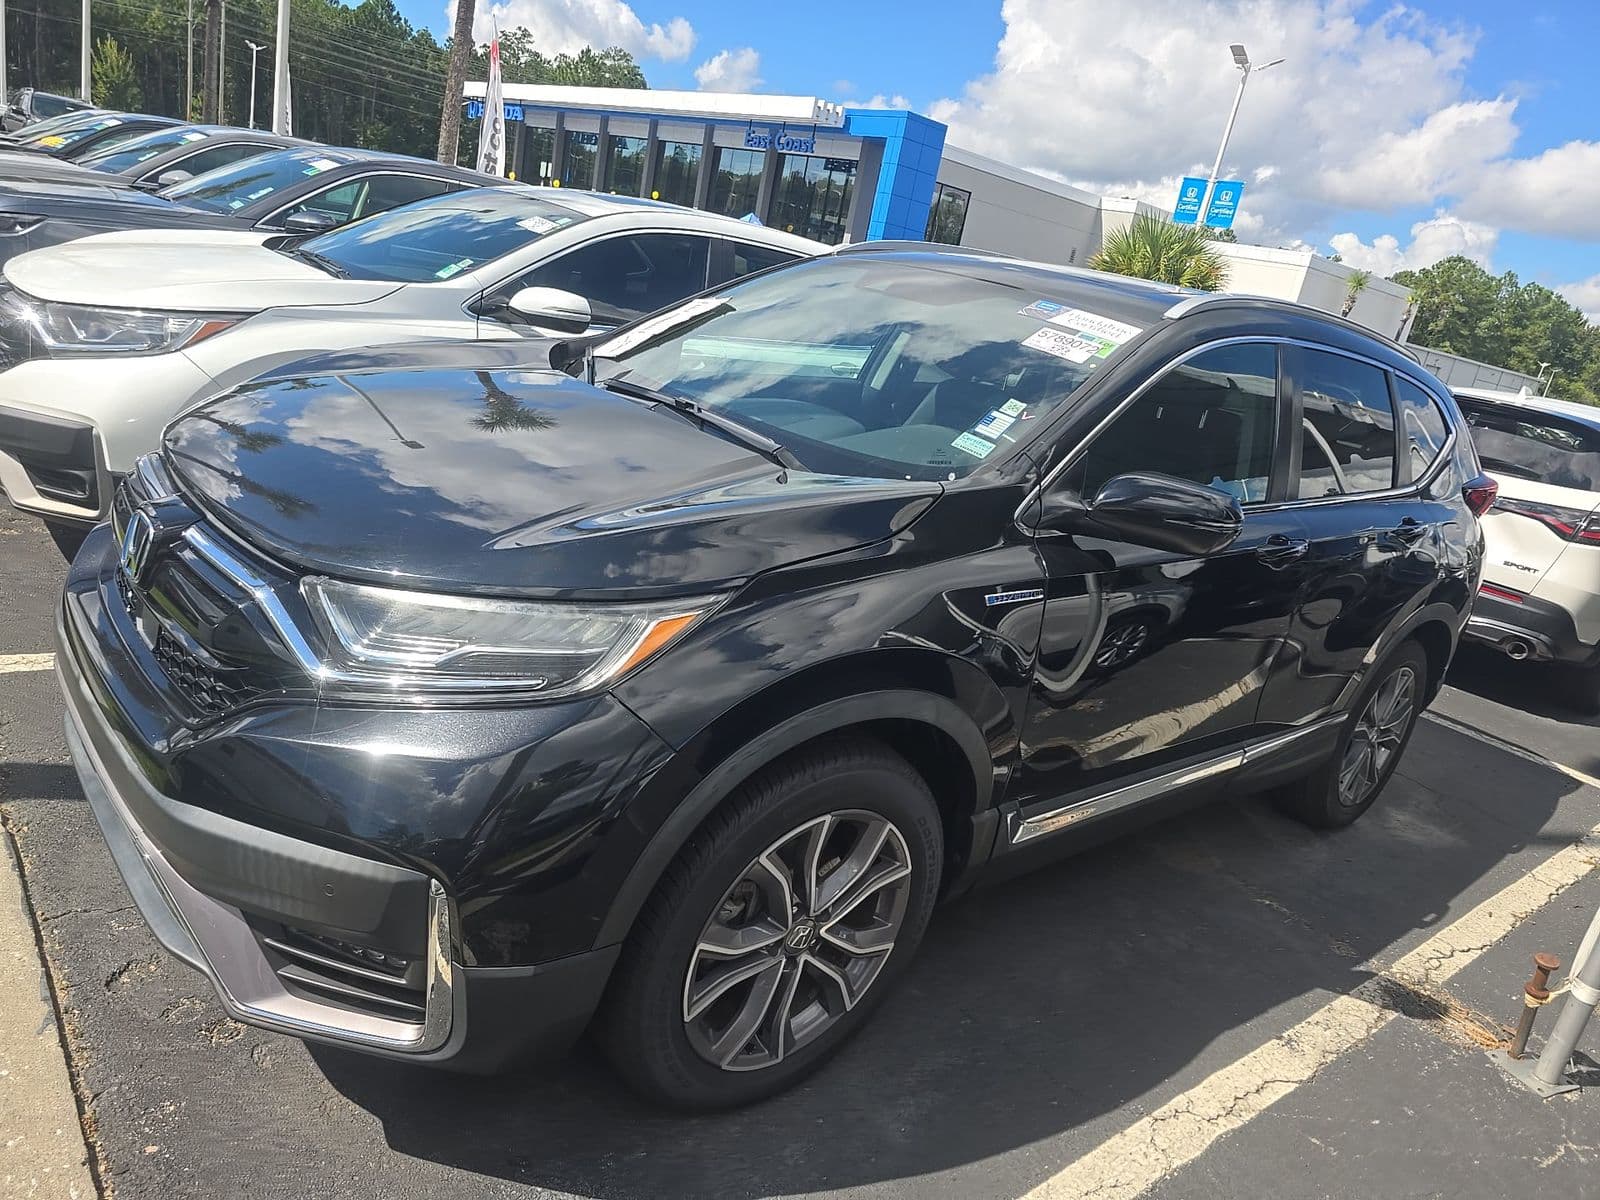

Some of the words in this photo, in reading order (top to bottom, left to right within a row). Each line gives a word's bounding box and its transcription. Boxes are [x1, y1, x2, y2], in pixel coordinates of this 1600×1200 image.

[477, 103, 524, 121] HDA
[745, 128, 772, 149] East
[774, 130, 816, 154] Coast
[1036, 329, 1101, 354] 5789072
[1503, 560, 1539, 573] SPORT
